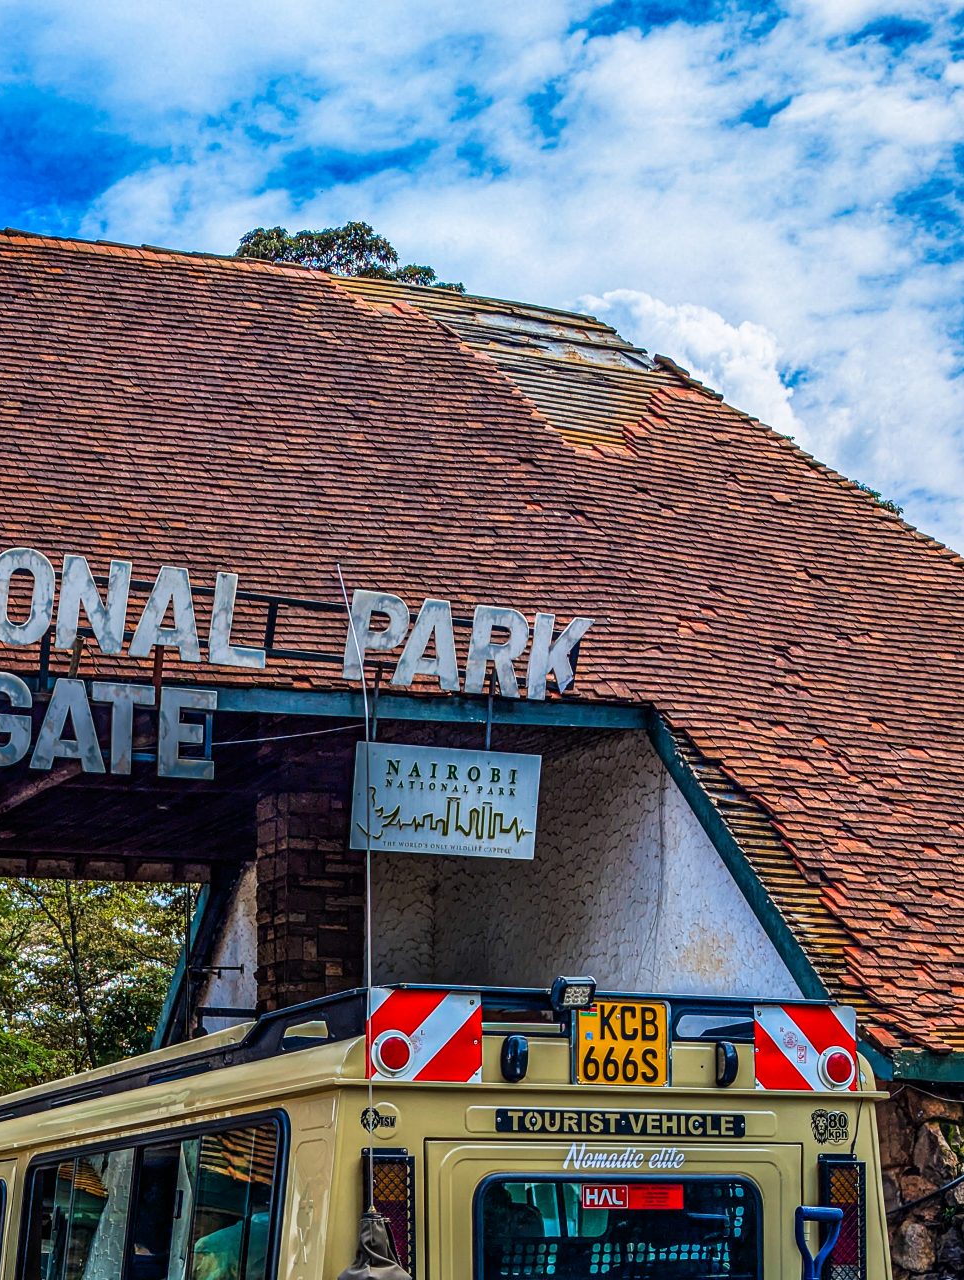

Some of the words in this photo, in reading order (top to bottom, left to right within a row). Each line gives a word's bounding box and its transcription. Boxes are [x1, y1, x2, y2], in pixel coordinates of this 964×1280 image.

[342, 589, 595, 701] PARK
[386, 759, 518, 785] NAIROBI
[385, 778, 469, 795] NATIONAL
[476, 785, 517, 797] PARK
[599, 1004, 659, 1042] KCB
[583, 1045, 659, 1083] 666S
[379, 1115, 397, 1128] TSV
[507, 1110, 622, 1134] TOURIST
[628, 1113, 735, 1136] VEHICLE
[828, 1112, 848, 1129] 80
[828, 1129, 848, 1142] kph
[562, 1141, 645, 1170] Nomadic
[648, 1147, 686, 1170] elite
[585, 1188, 624, 1206] HAL
